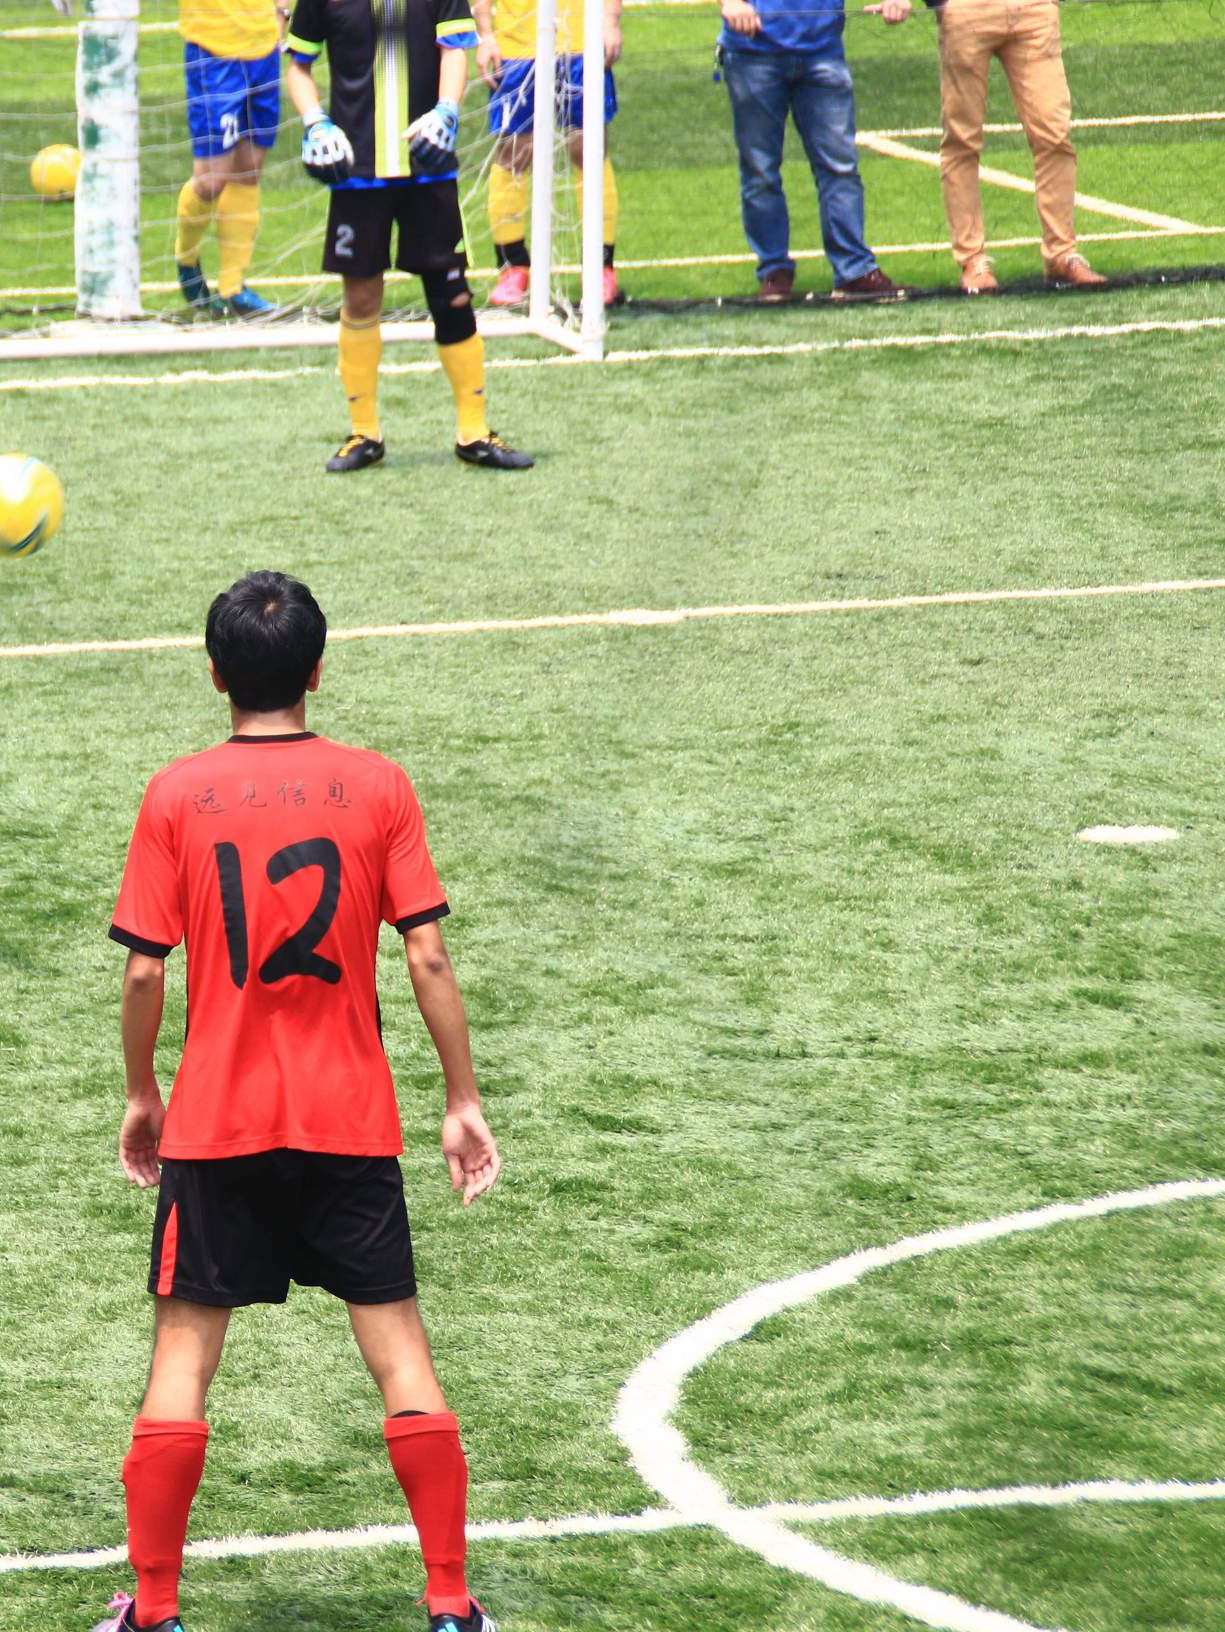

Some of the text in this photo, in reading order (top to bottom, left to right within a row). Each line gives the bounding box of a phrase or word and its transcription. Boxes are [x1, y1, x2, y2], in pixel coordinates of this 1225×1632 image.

[334, 224, 354, 258] 2
[192, 778, 352, 814] 远见信息
[214, 837, 341, 990] 12
